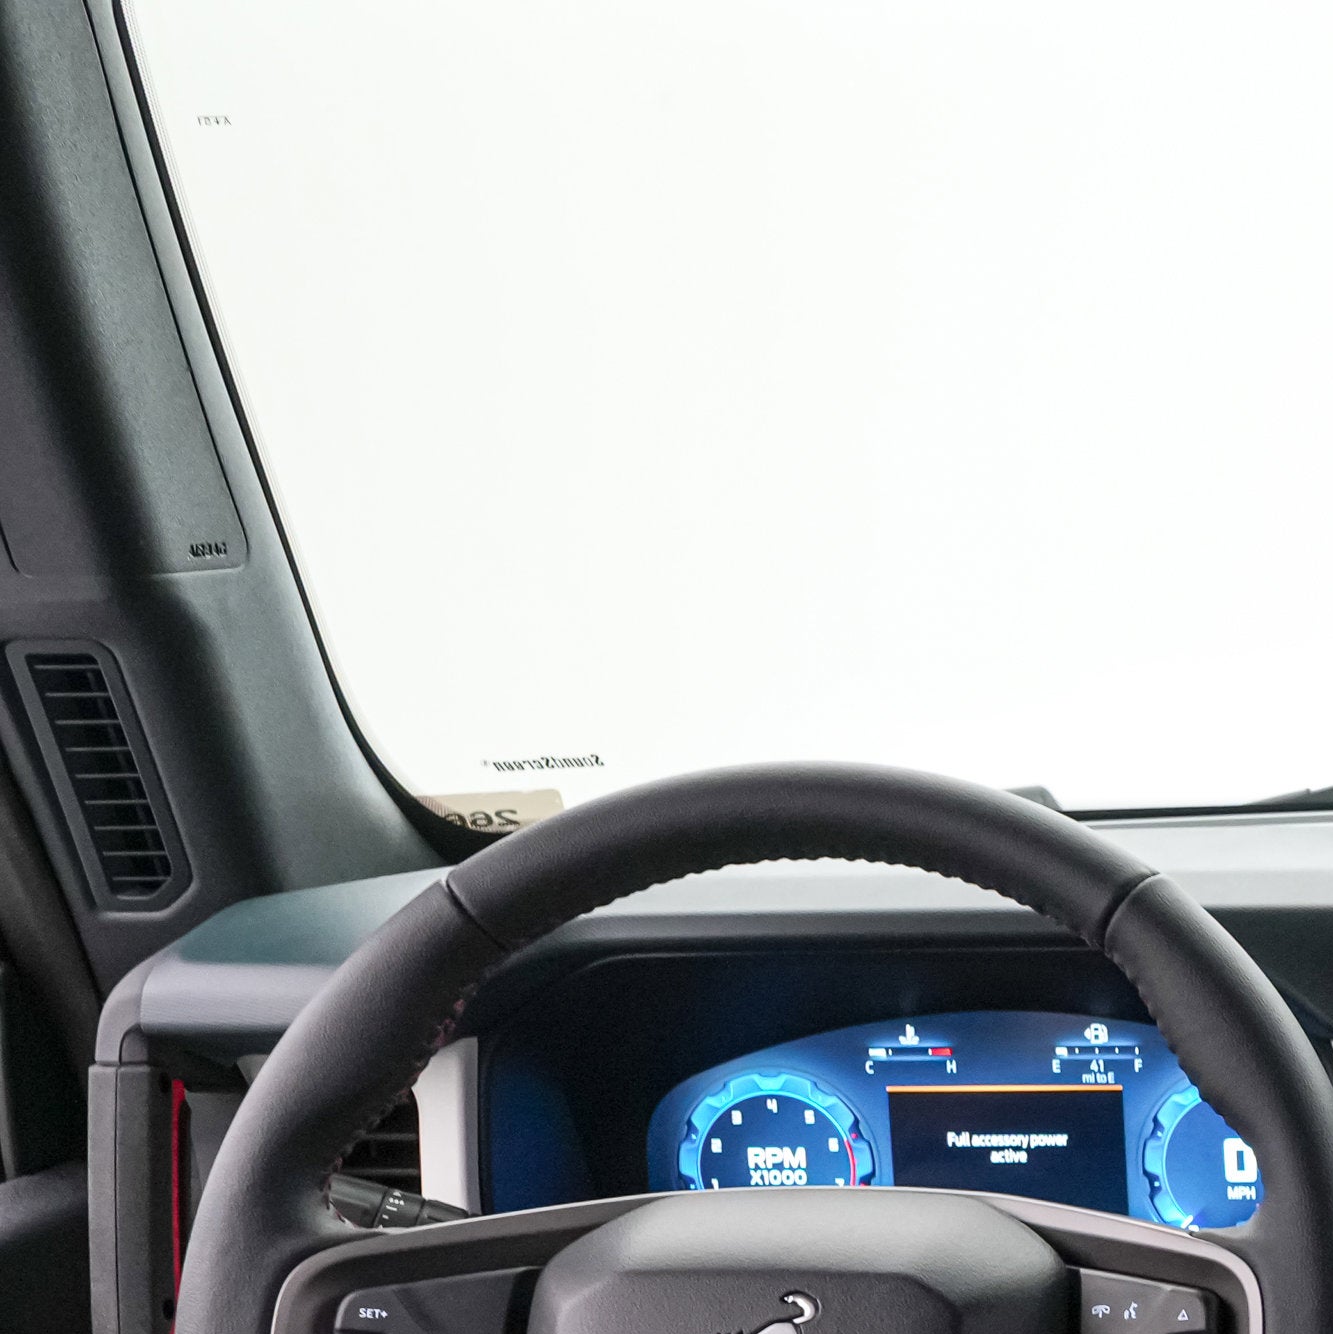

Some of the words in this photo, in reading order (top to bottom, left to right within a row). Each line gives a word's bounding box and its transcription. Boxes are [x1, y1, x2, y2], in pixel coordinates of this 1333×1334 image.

[865, 1060, 875, 1075] C
[946, 1059, 957, 1074] H
[1052, 1059, 1062, 1073] E
[1089, 1058, 1104, 1073] 41
[1134, 1058, 1143, 1073] F
[1096, 1072, 1107, 1084] to
[766, 1098, 778, 1114] 4
[947, 1131, 970, 1148] Full
[971, 1134, 1029, 1150] accessory
[1030, 1134, 1069, 1150] power
[747, 1146, 807, 1169] RPM
[990, 1148, 1028, 1164] active
[749, 1168, 808, 1186] X1000
[1226, 1185, 1257, 1201] MPH
